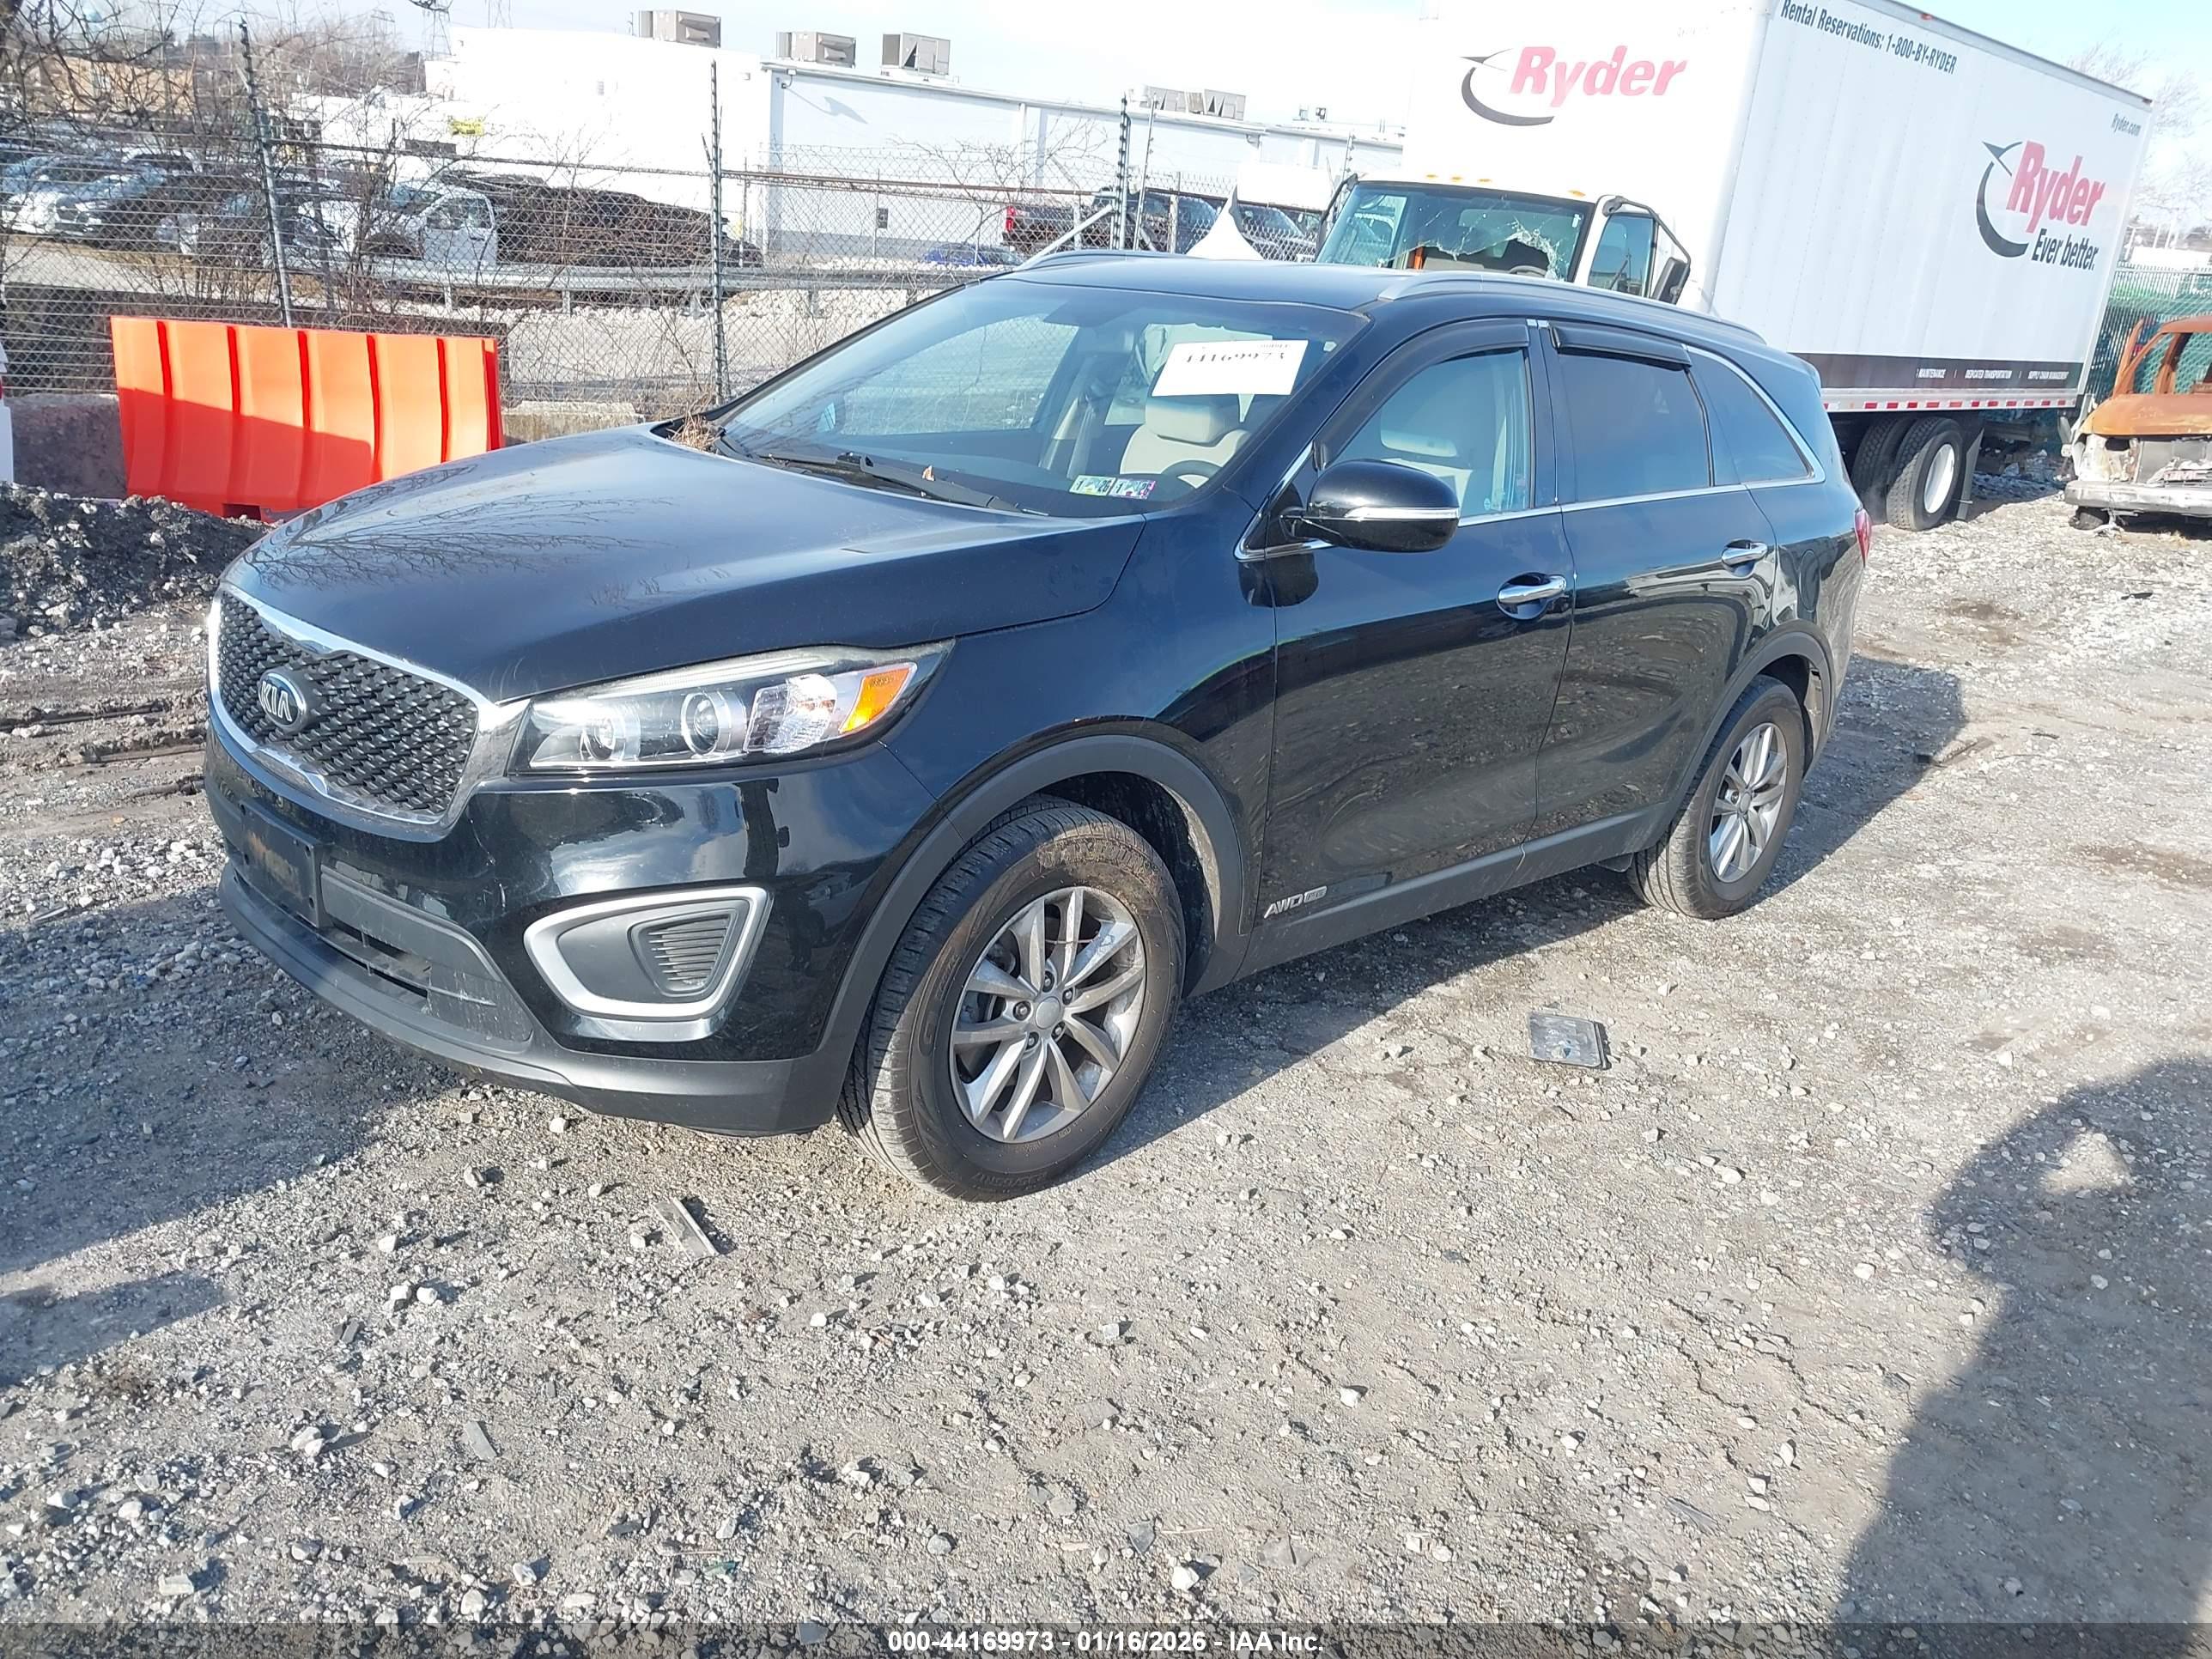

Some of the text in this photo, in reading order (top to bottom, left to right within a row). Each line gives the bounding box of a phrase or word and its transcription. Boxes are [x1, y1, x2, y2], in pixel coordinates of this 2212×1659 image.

[1780, 0, 1958, 76] Rental Reservations: 1-800-BY-RYDER
[1508, 45, 1688, 108] Ryder
[2111, 112, 2142, 137] Ryder.com
[2005, 139, 2106, 234] Ryder
[2031, 228, 2100, 271] Ever better.
[261, 679, 293, 722] KIA
[1263, 893, 1304, 919] AWD
